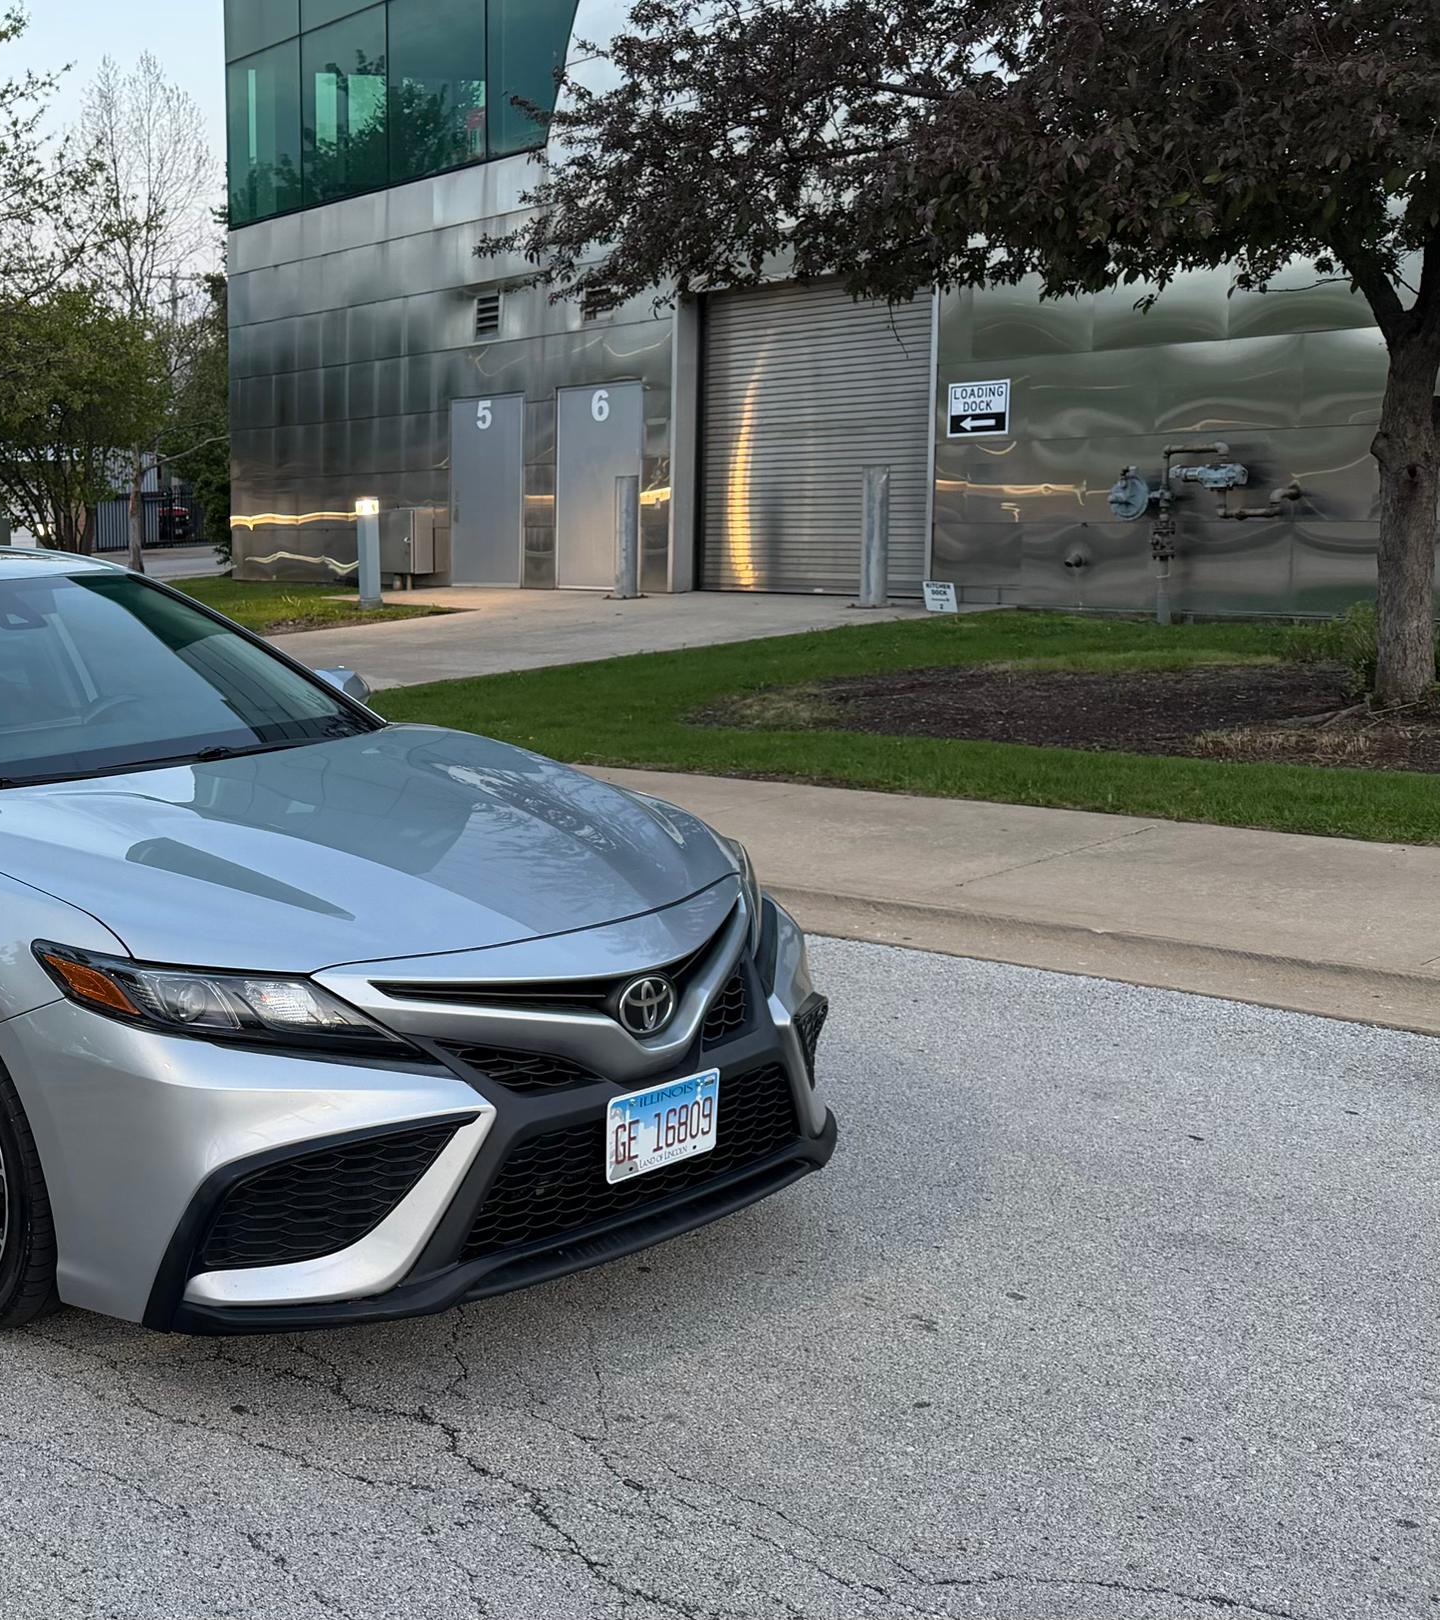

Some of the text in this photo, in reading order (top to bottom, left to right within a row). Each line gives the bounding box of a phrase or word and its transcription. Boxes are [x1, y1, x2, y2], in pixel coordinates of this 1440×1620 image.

[591, 390, 609, 421] 6
[953, 386, 1004, 400] LOADING
[963, 400, 992, 412] DOCK
[476, 400, 492, 429] 5
[639, 1083, 693, 1107] ILLINOIS
[615, 1096, 713, 1165] GE 16809
